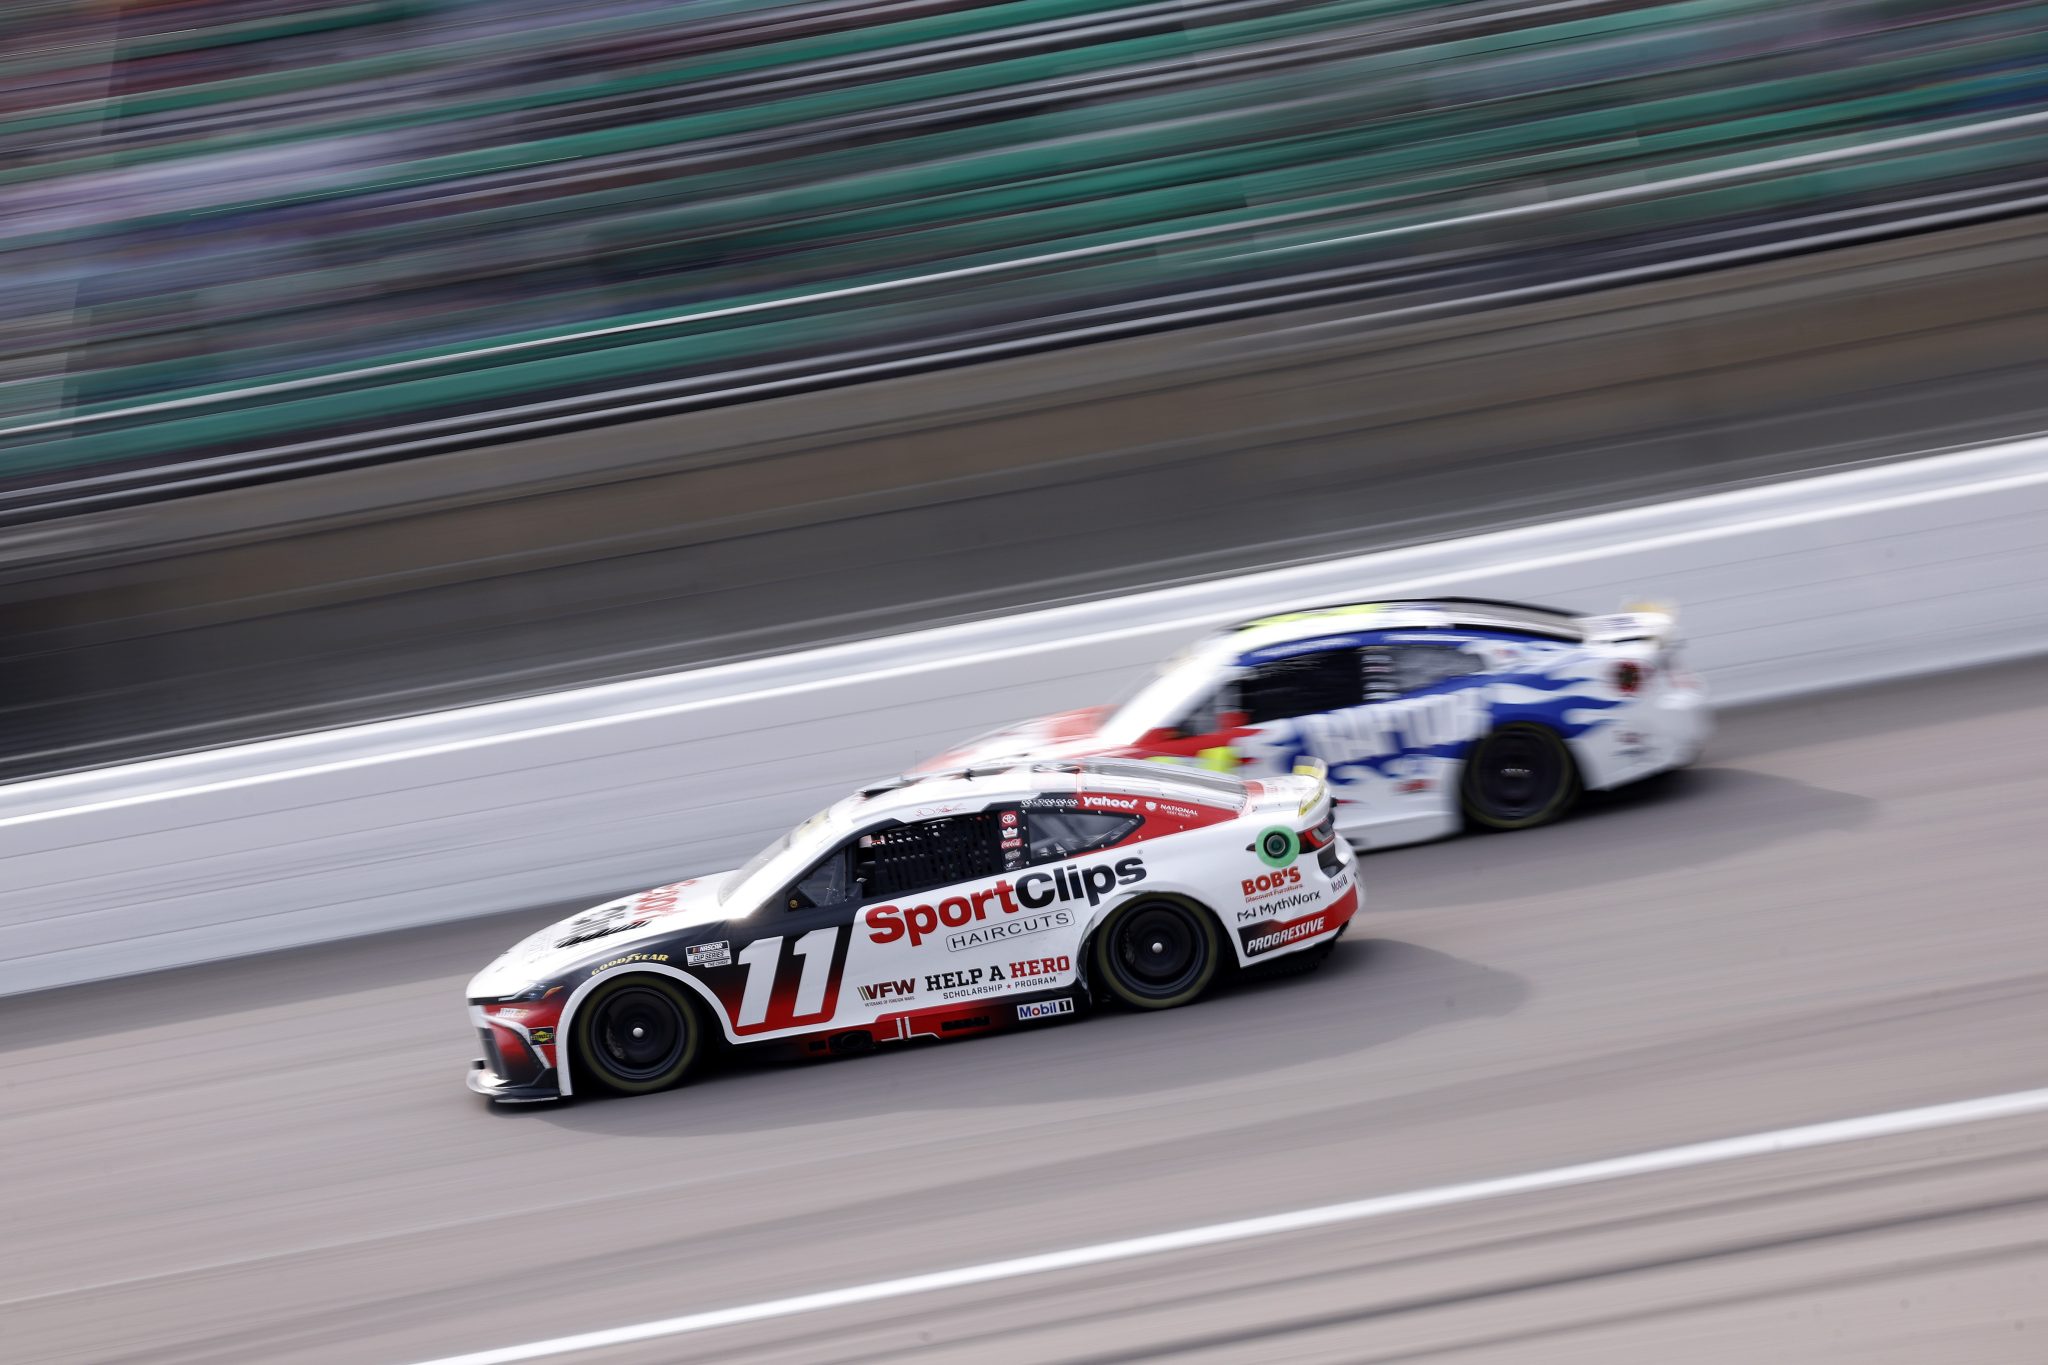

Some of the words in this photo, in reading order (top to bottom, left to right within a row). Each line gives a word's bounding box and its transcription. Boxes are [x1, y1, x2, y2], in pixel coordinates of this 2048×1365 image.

[1083, 796, 1139, 809] yahoo!
[1160, 804, 1198, 816] NATIONAL
[1241, 866, 1302, 896] BOB'S
[865, 857, 1147, 947] SportClips
[1260, 890, 1321, 915] MythWorx
[952, 912, 1069, 949] HAIRCUTS
[1246, 917, 1325, 954] PROGRESSIVE
[700, 942, 723, 952] NASCAR
[591, 953, 669, 976] GOODYEAR
[737, 926, 839, 1027] 11
[925, 968, 983, 992] HELP
[989, 965, 1005, 982] A
[1009, 955, 1071, 979] HERO
[865, 978, 916, 1000] VFW
[943, 984, 1003, 1000] SCHOLARSHIP
[1015, 976, 1057, 988] PROGRAM
[1019, 1002, 1057, 1019] Mobil
